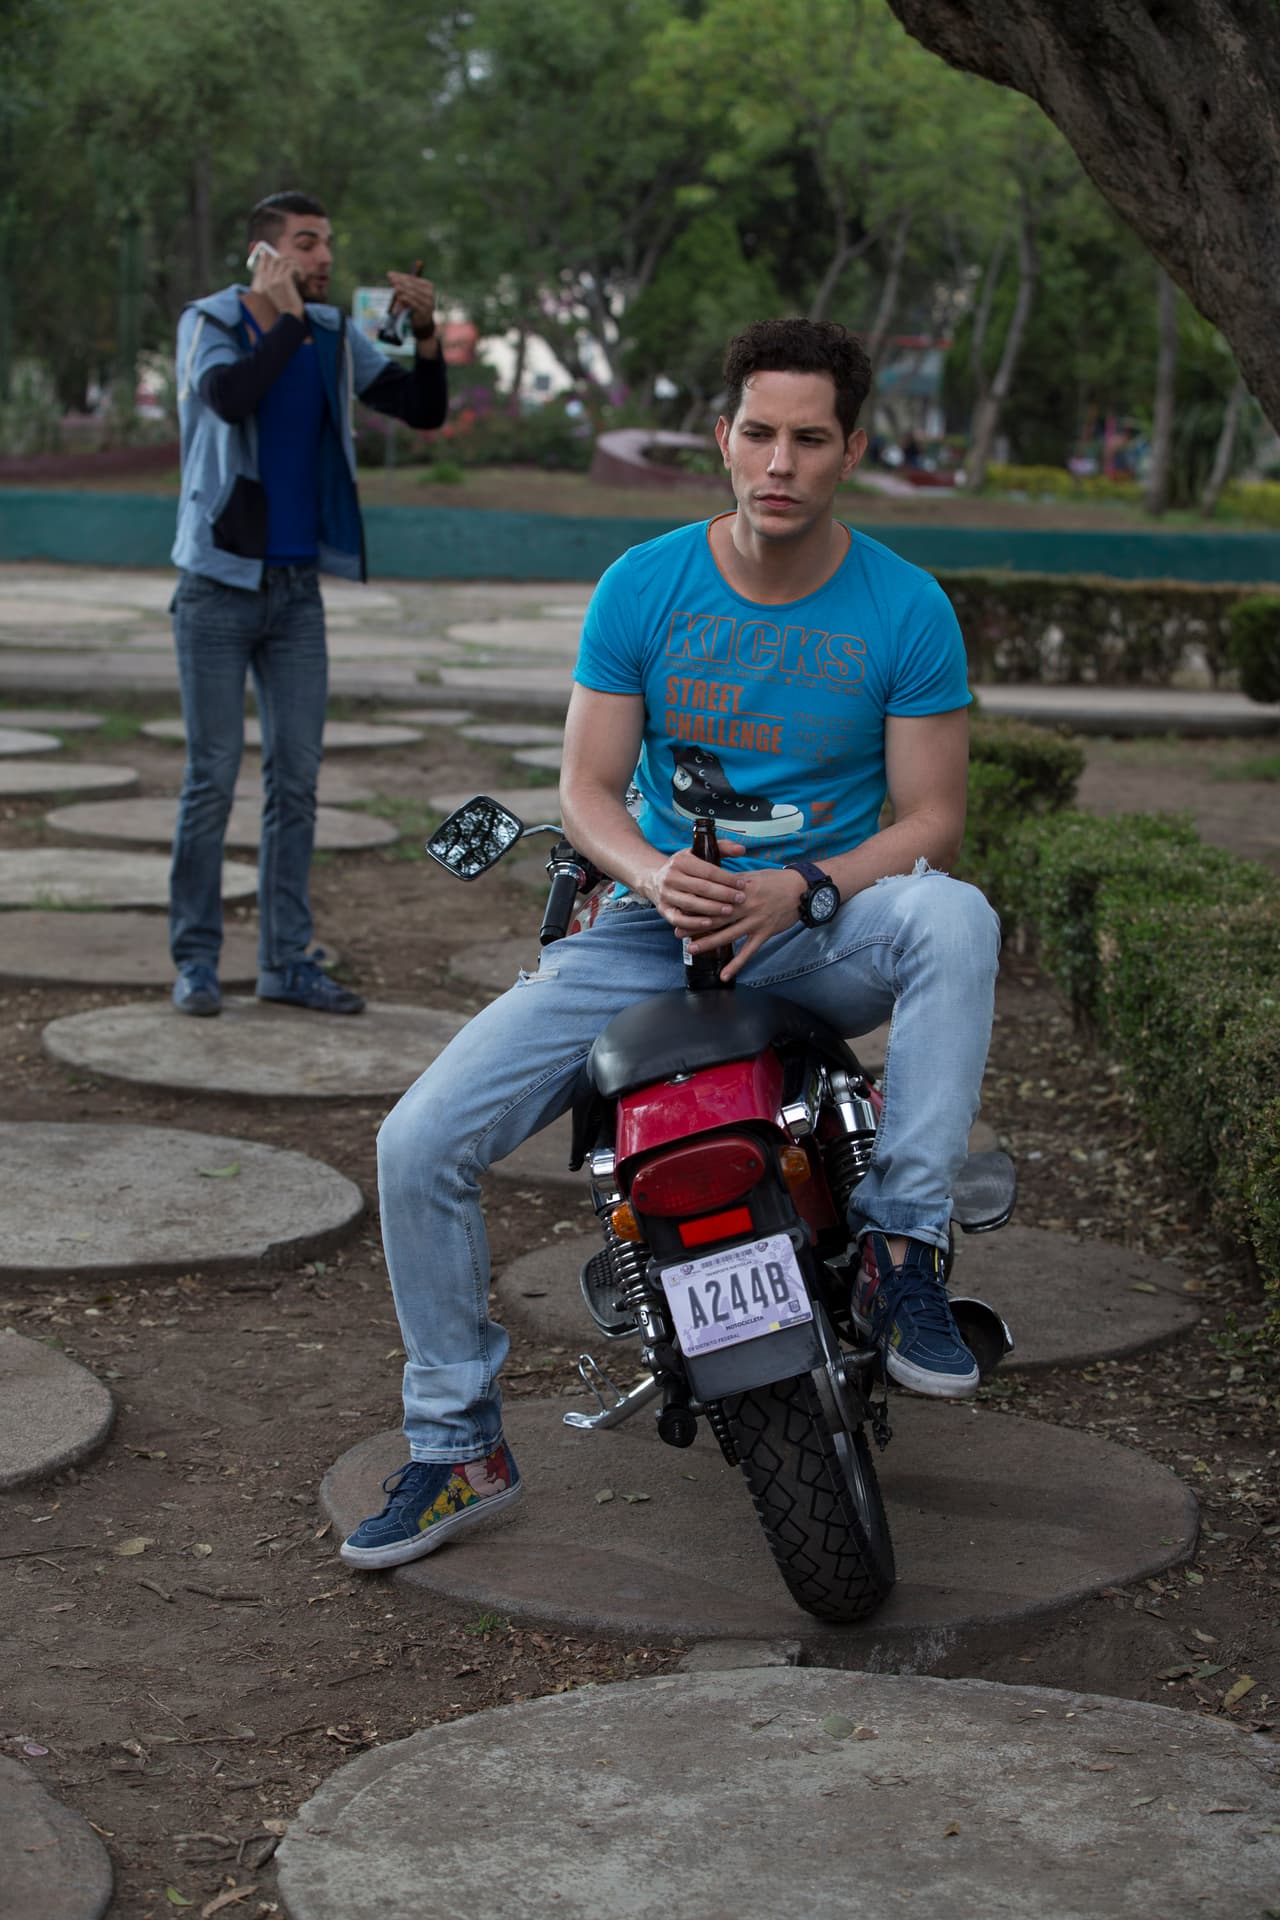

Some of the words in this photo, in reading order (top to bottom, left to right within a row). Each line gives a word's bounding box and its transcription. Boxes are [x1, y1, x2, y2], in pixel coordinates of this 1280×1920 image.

[665, 611, 867, 684] KICKS
[665, 675, 745, 715] STREET
[665, 709, 783, 754] CHALLENGE
[687, 1262, 790, 1330] A244B
[726, 1315, 764, 1331] MOTOCICLETA
